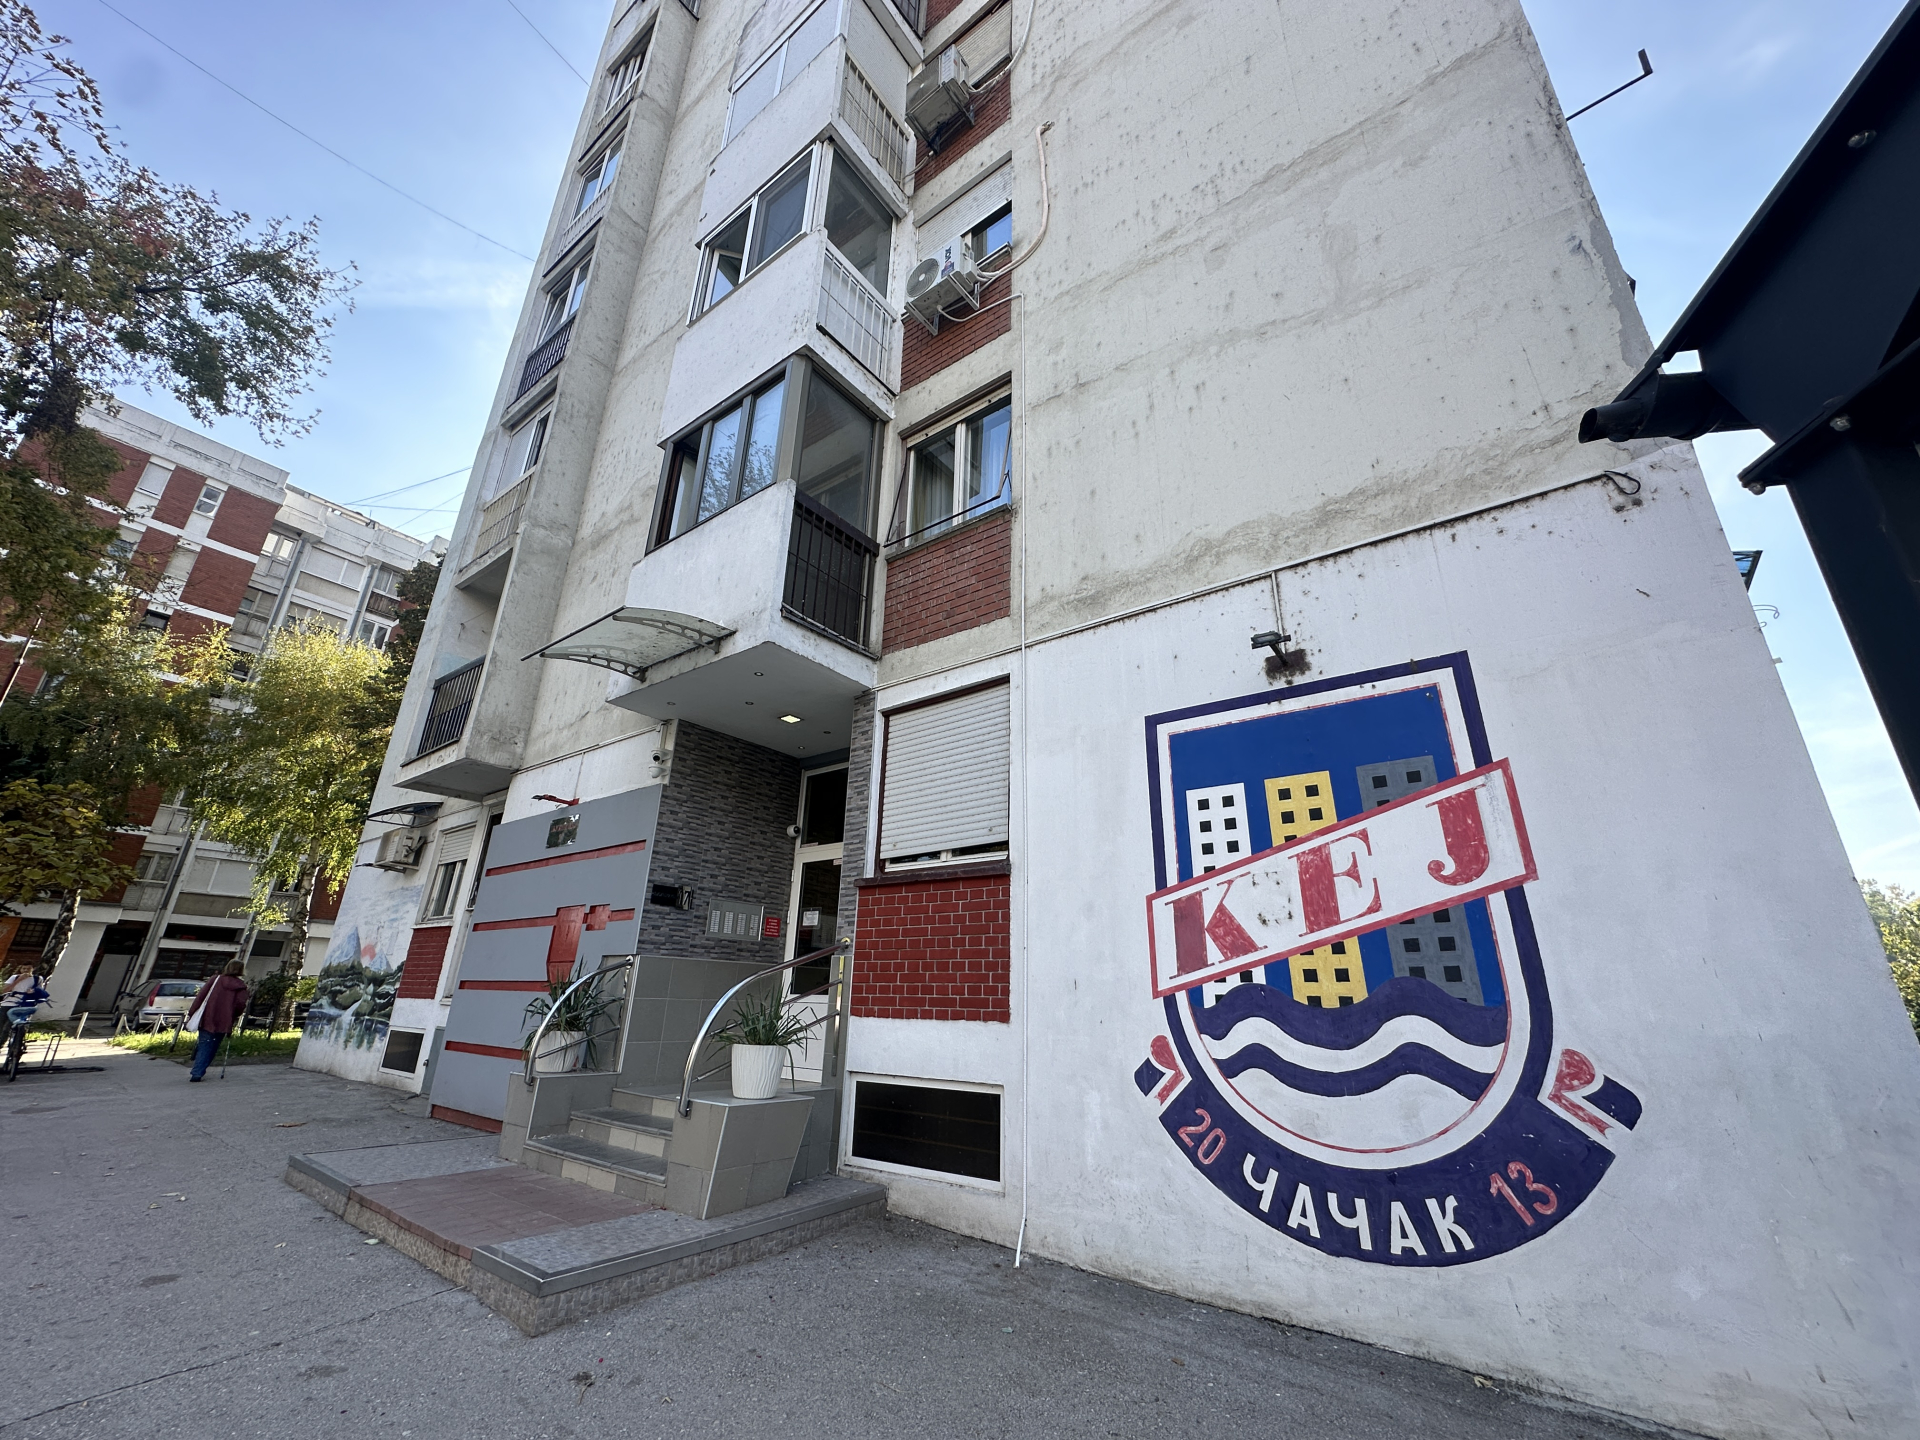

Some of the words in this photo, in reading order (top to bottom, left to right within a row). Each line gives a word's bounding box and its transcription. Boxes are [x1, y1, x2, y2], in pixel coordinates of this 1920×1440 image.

[1177, 1108, 1227, 1165] 20
[1242, 1153, 1475, 1256] ЧАЧАК
[1489, 1161, 1559, 1227] 13
